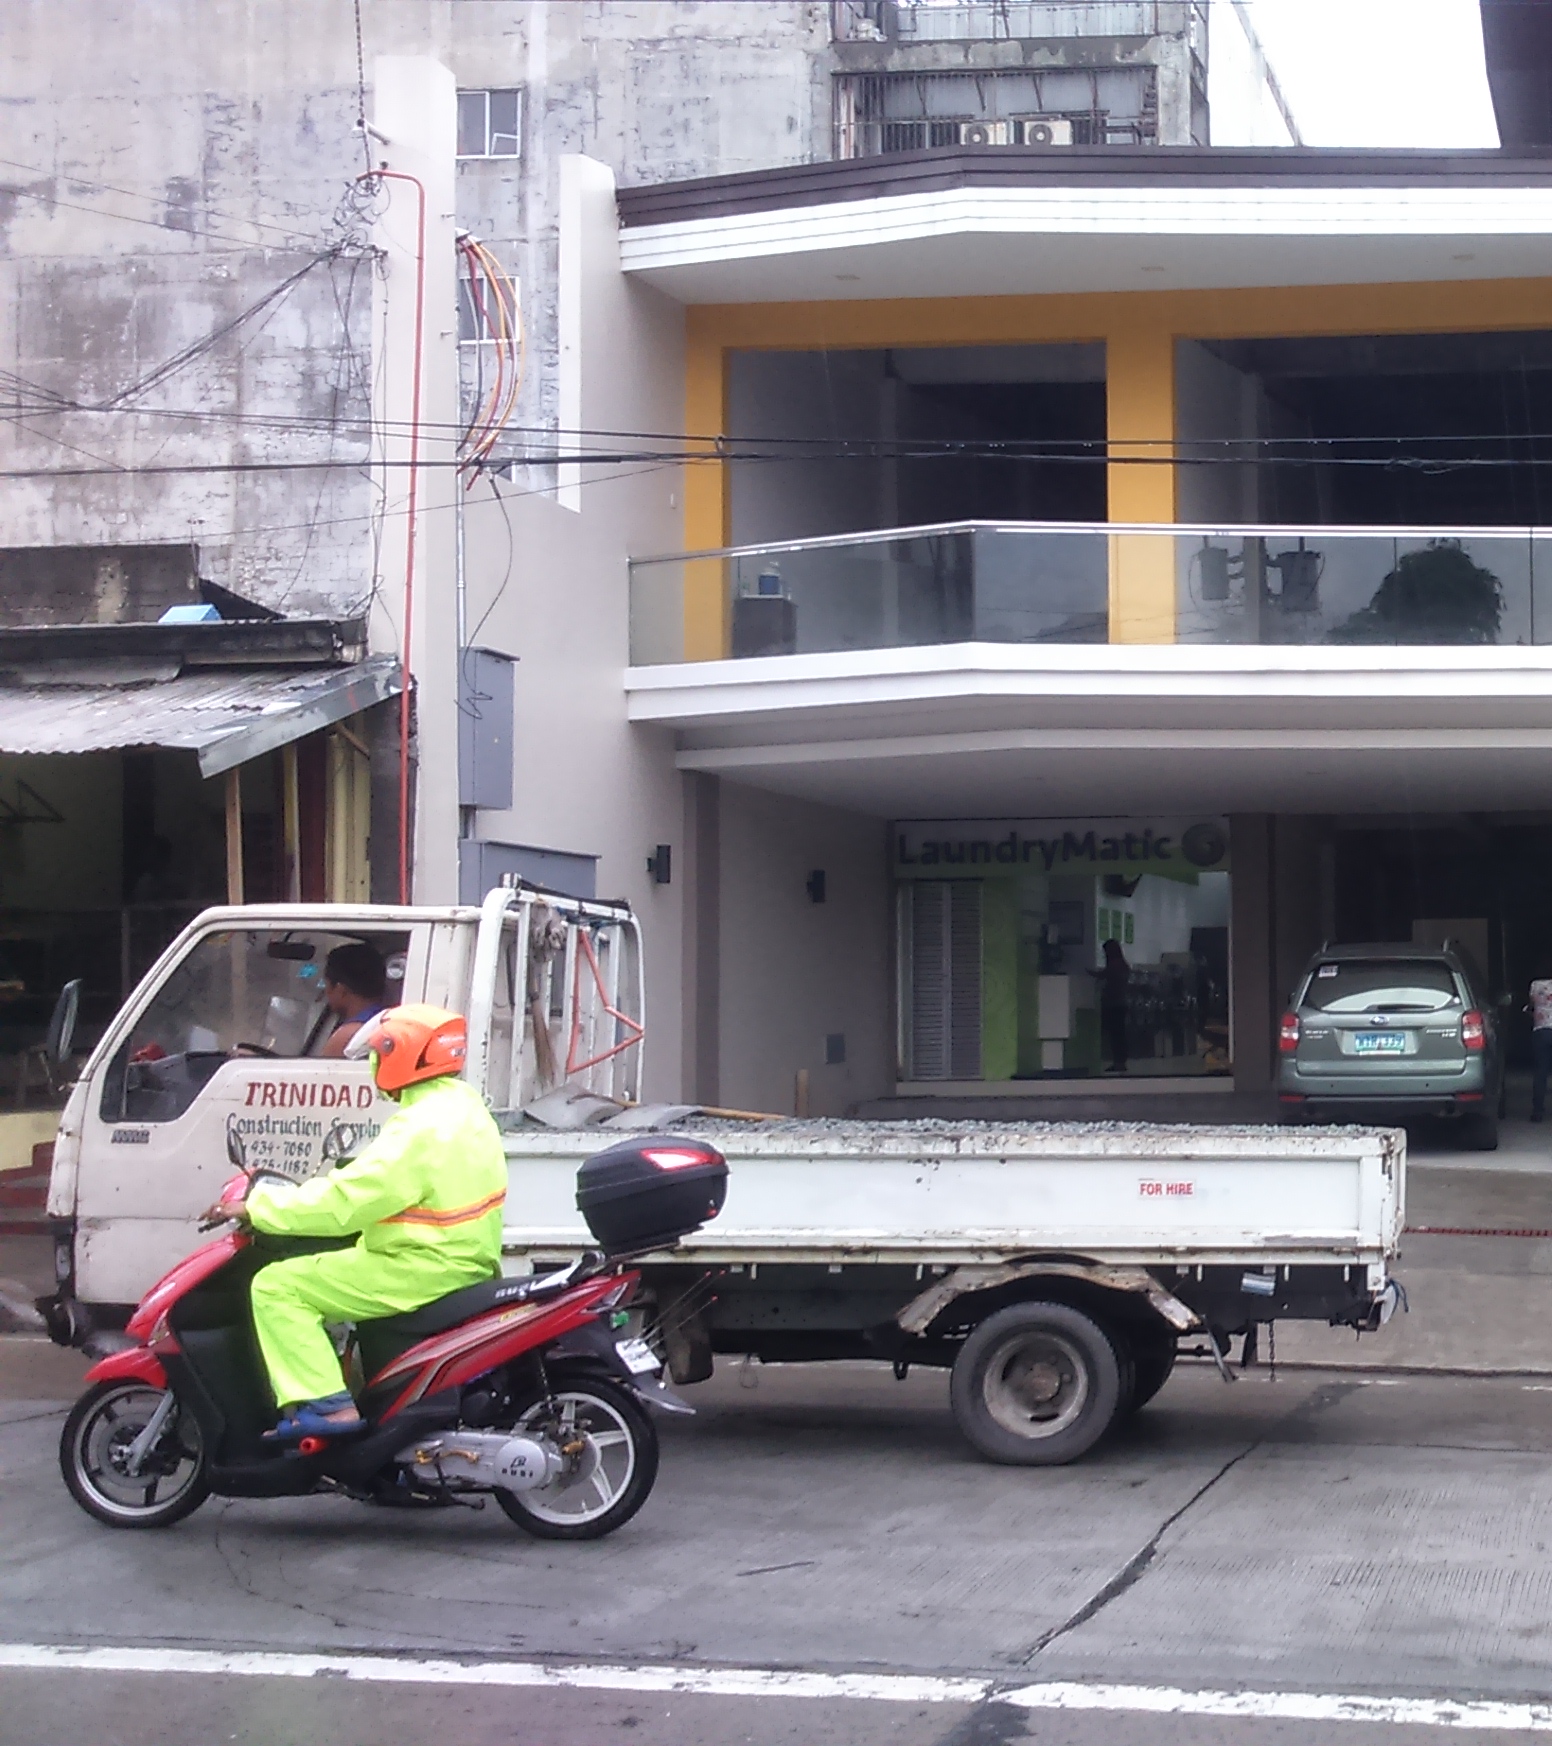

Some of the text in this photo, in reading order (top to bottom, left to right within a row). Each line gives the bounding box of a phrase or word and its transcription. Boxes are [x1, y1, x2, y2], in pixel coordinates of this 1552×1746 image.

[899, 830, 1173, 871] LaundryMatic
[244, 1081, 373, 1109] TRINIDAD
[1139, 1182, 1194, 1196] FOR HIRE
